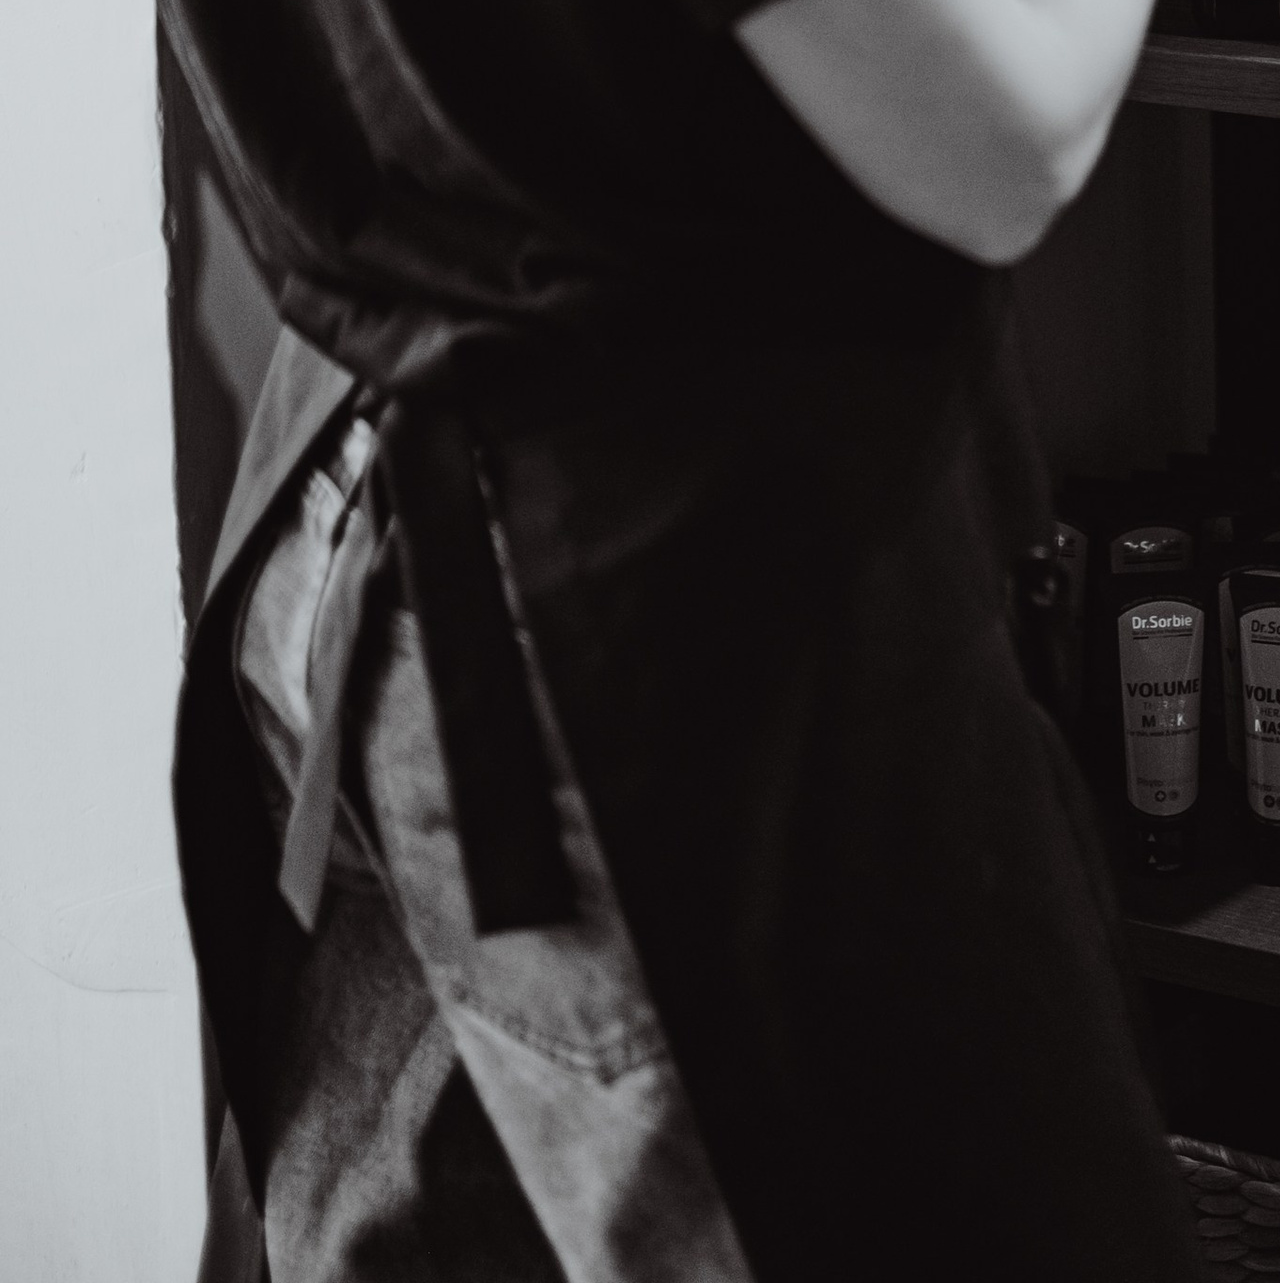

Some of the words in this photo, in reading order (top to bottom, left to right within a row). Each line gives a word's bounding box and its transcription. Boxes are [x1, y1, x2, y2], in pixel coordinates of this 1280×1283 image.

[1131, 614, 1193, 630] Dr.Sorbie
[1126, 678, 1200, 698] VOLUME
[1141, 714, 1188, 729] MK
